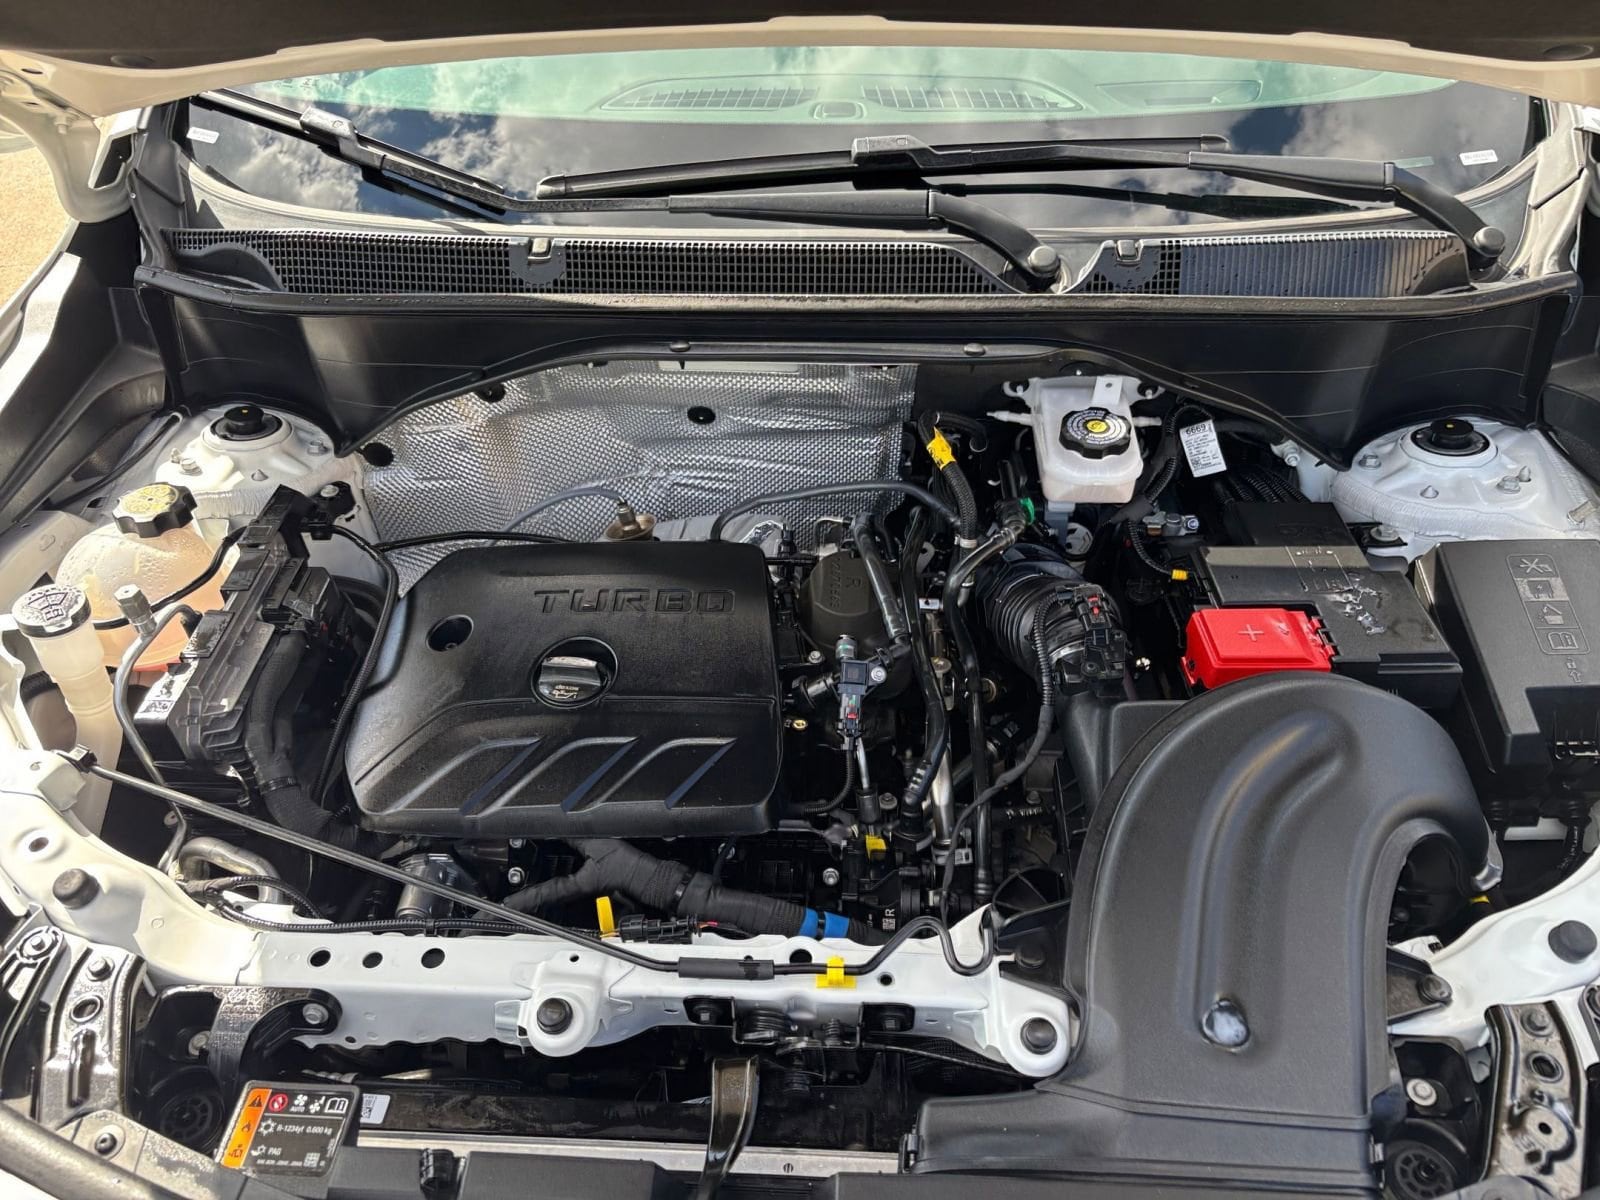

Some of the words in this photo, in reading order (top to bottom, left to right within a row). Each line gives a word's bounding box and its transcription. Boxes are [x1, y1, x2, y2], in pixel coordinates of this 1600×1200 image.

[534, 589, 736, 613] TURBO
[324, 1127, 332, 1135] kg
[268, 1147, 282, 1155] PAG
